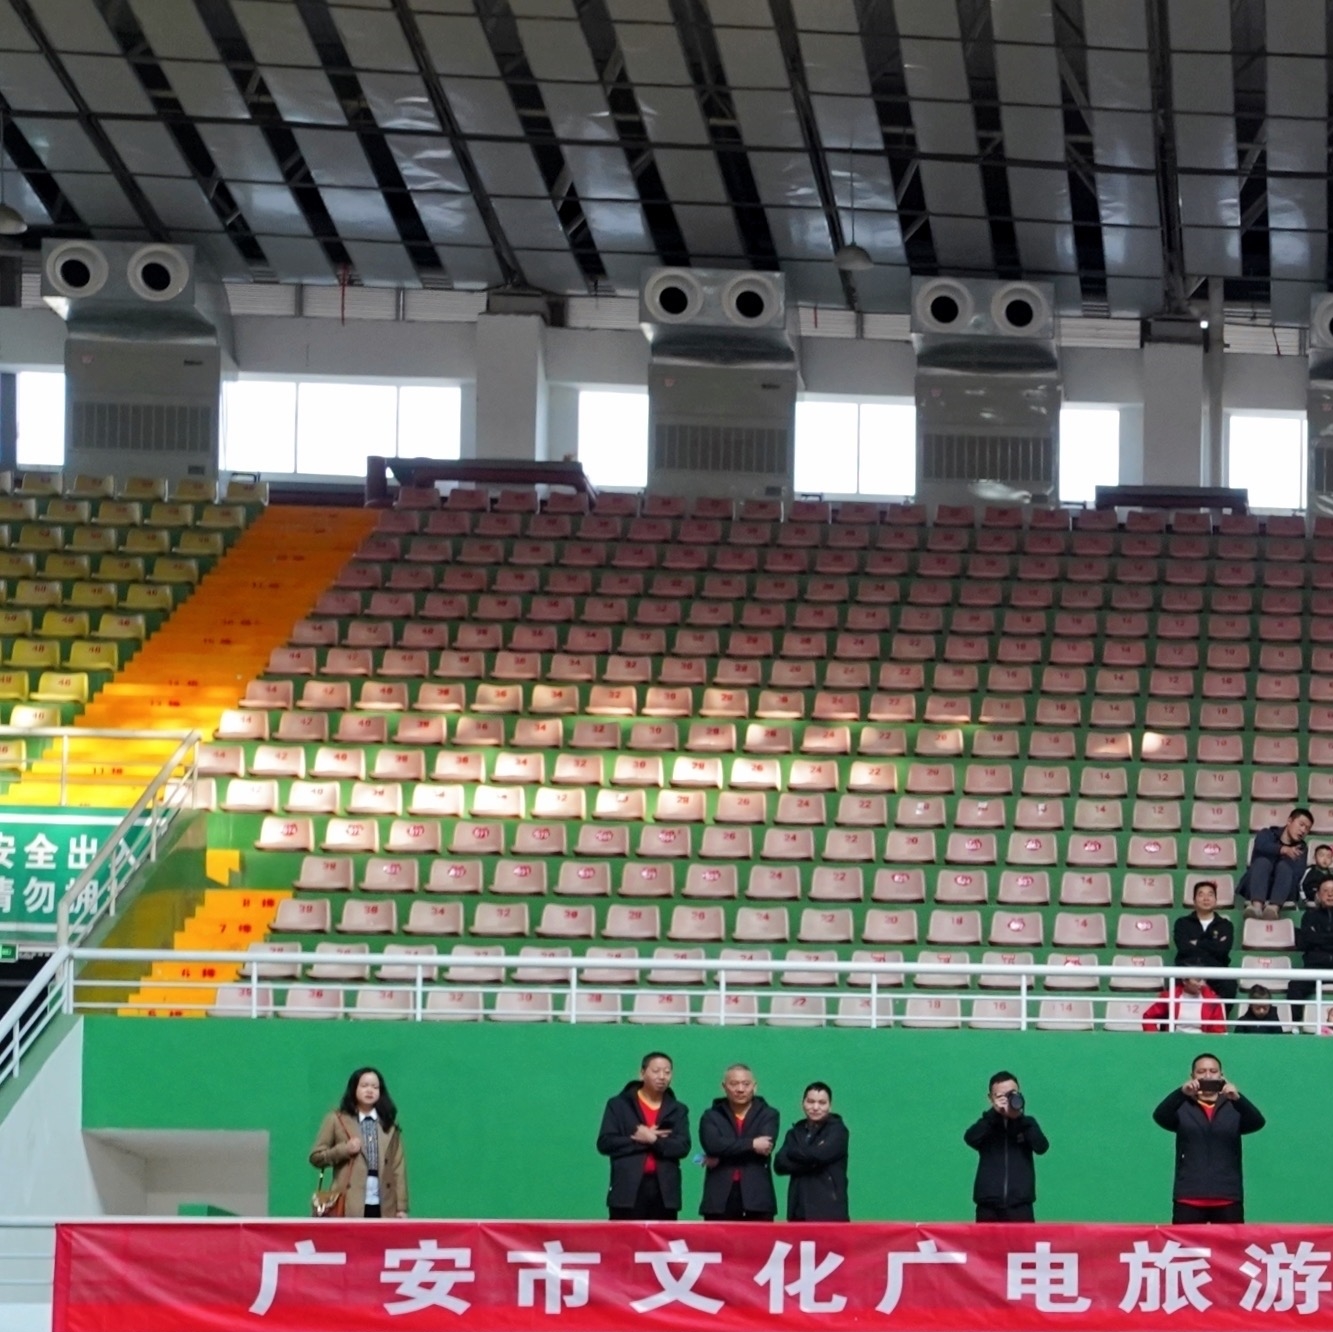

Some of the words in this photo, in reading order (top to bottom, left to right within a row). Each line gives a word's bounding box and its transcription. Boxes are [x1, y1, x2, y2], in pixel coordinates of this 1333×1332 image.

[1158, 773, 1169, 781] 12
[1213, 774, 1224, 782] 10
[859, 799, 872, 809] 22
[1152, 805, 1164, 814] 12
[724, 832, 736, 840] 26
[1081, 876, 1093, 885] 14
[1127, 1004, 1140, 1014] 12
